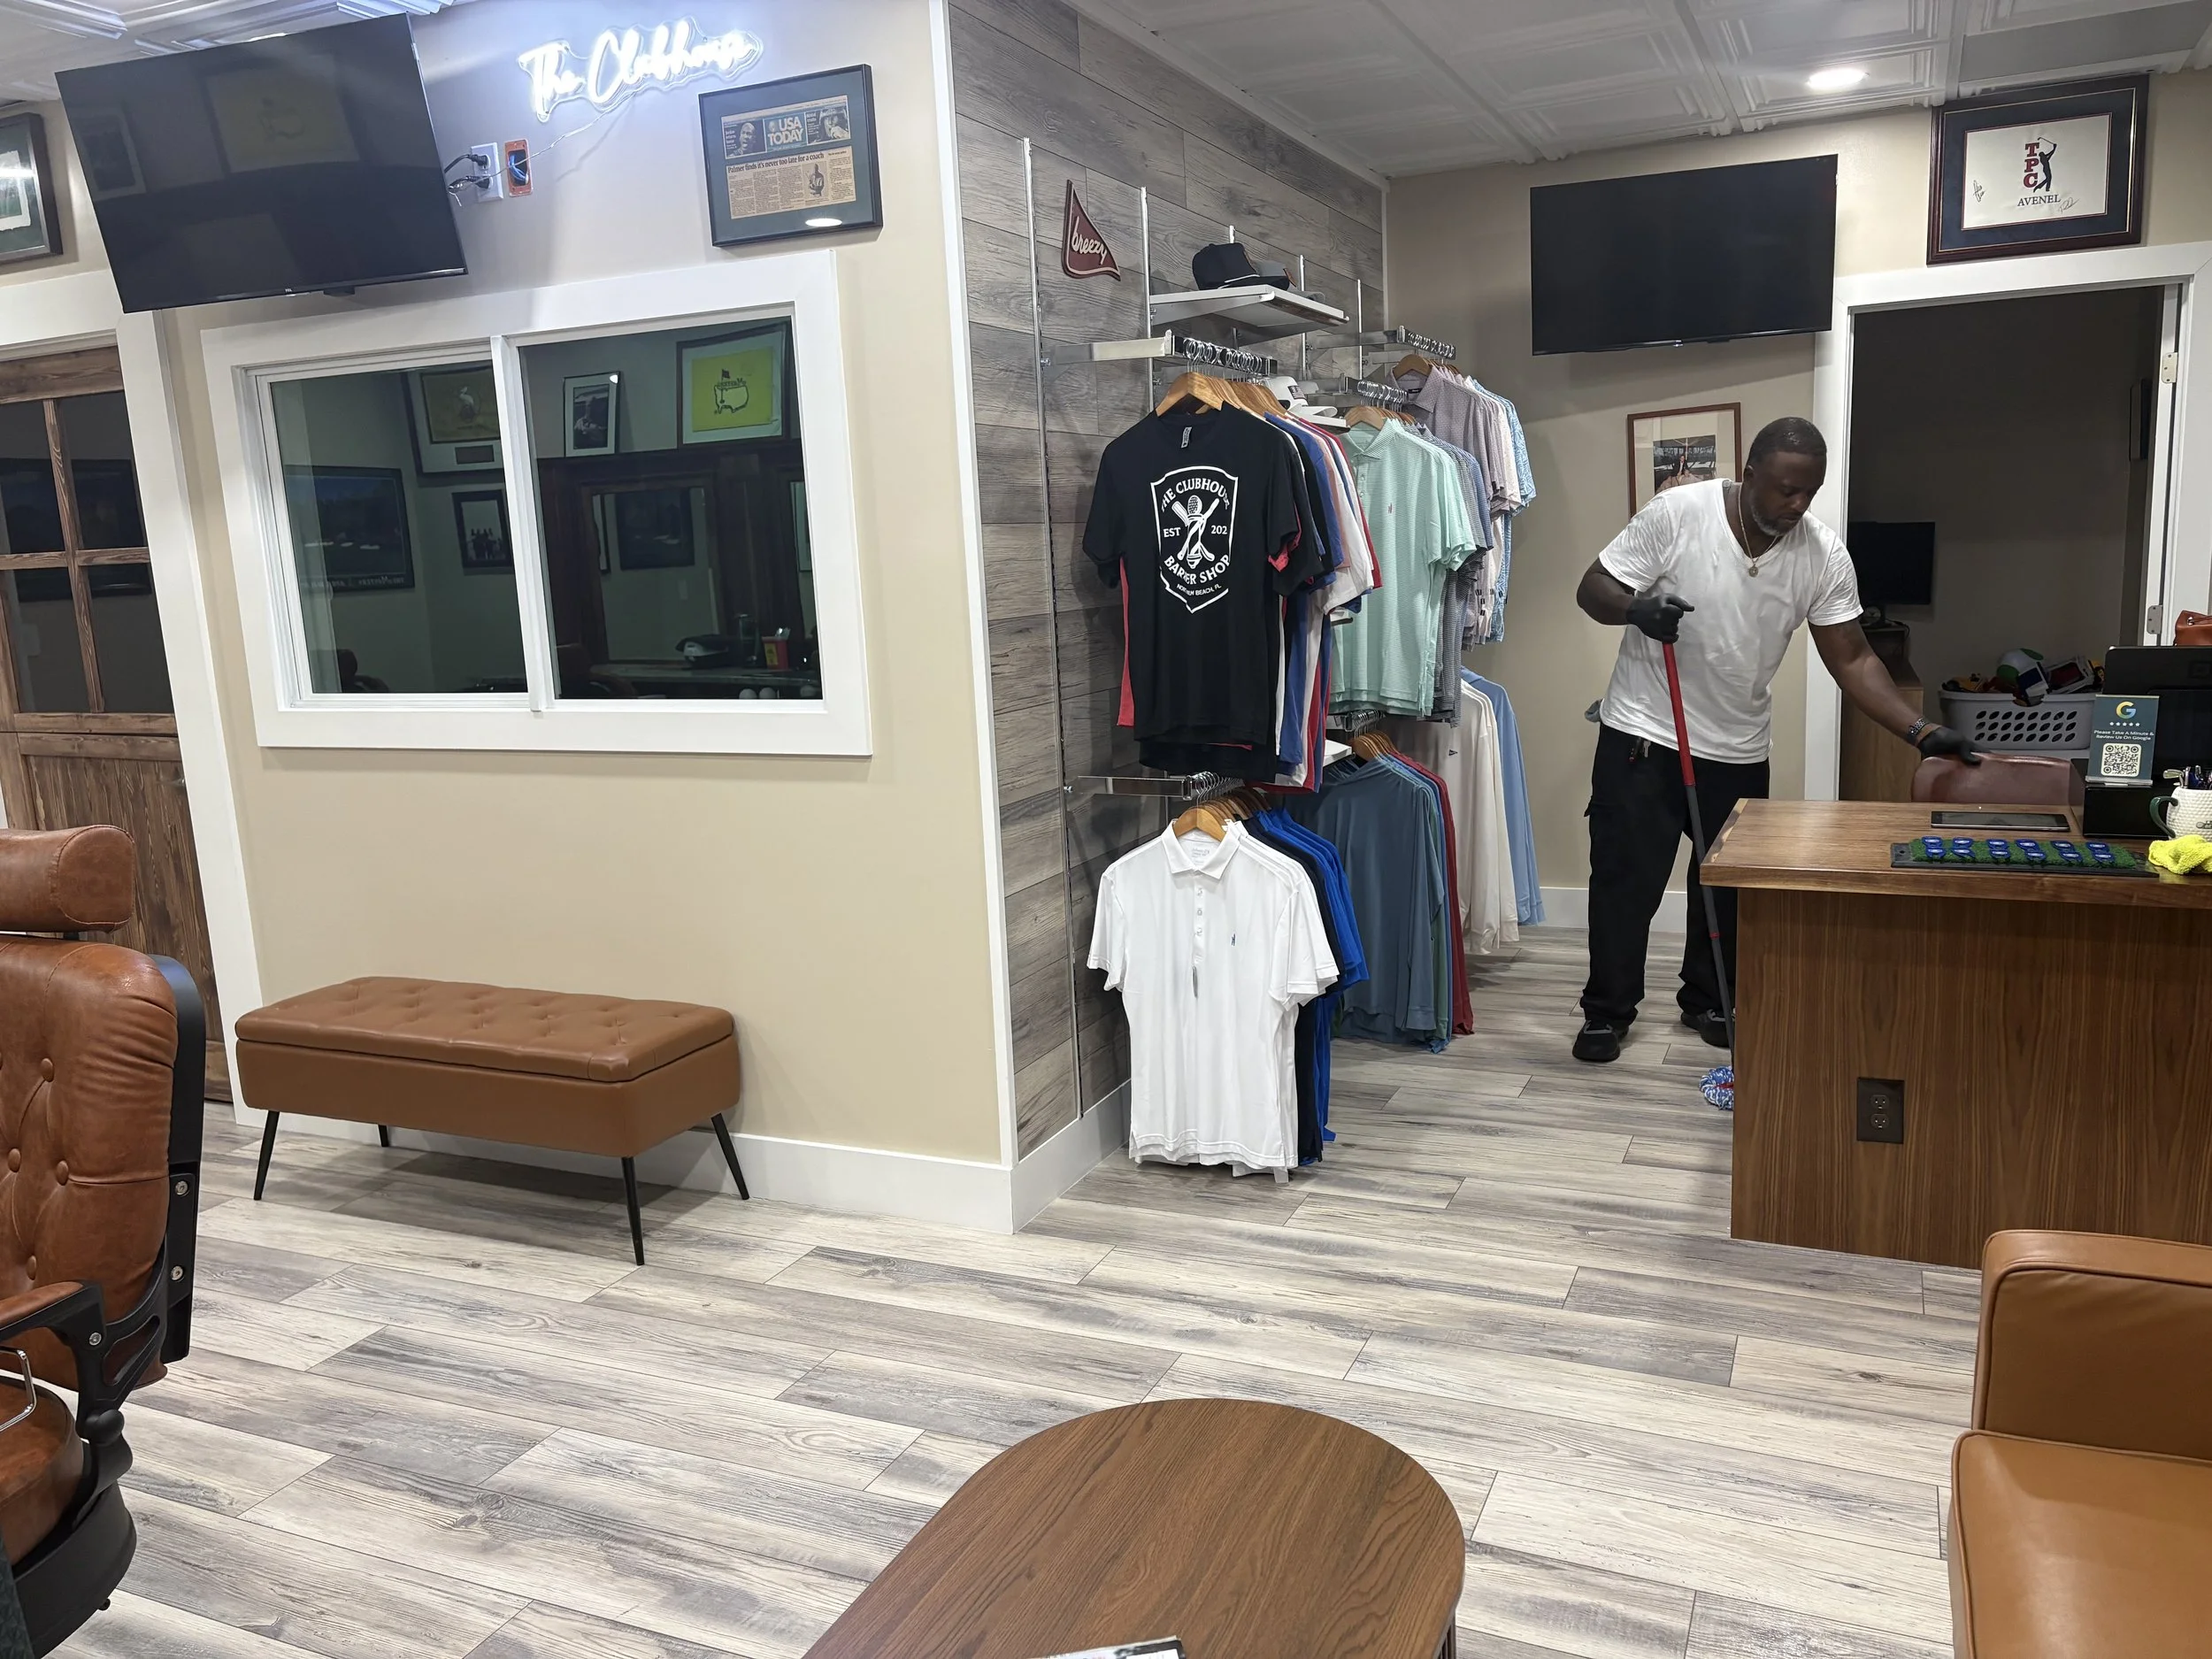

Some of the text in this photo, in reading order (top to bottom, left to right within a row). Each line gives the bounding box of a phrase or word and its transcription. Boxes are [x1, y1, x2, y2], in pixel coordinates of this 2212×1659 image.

[518, 42, 587, 116] The
[779, 116, 803, 132] USA
[767, 128, 804, 146] TODAY
[809, 151, 825, 161] coach
[2017, 194, 2061, 207] AVENEL
[1071, 215, 1107, 265] breezy
[1163, 526, 1181, 538] EST
[1199, 554, 1230, 584] SHOP
